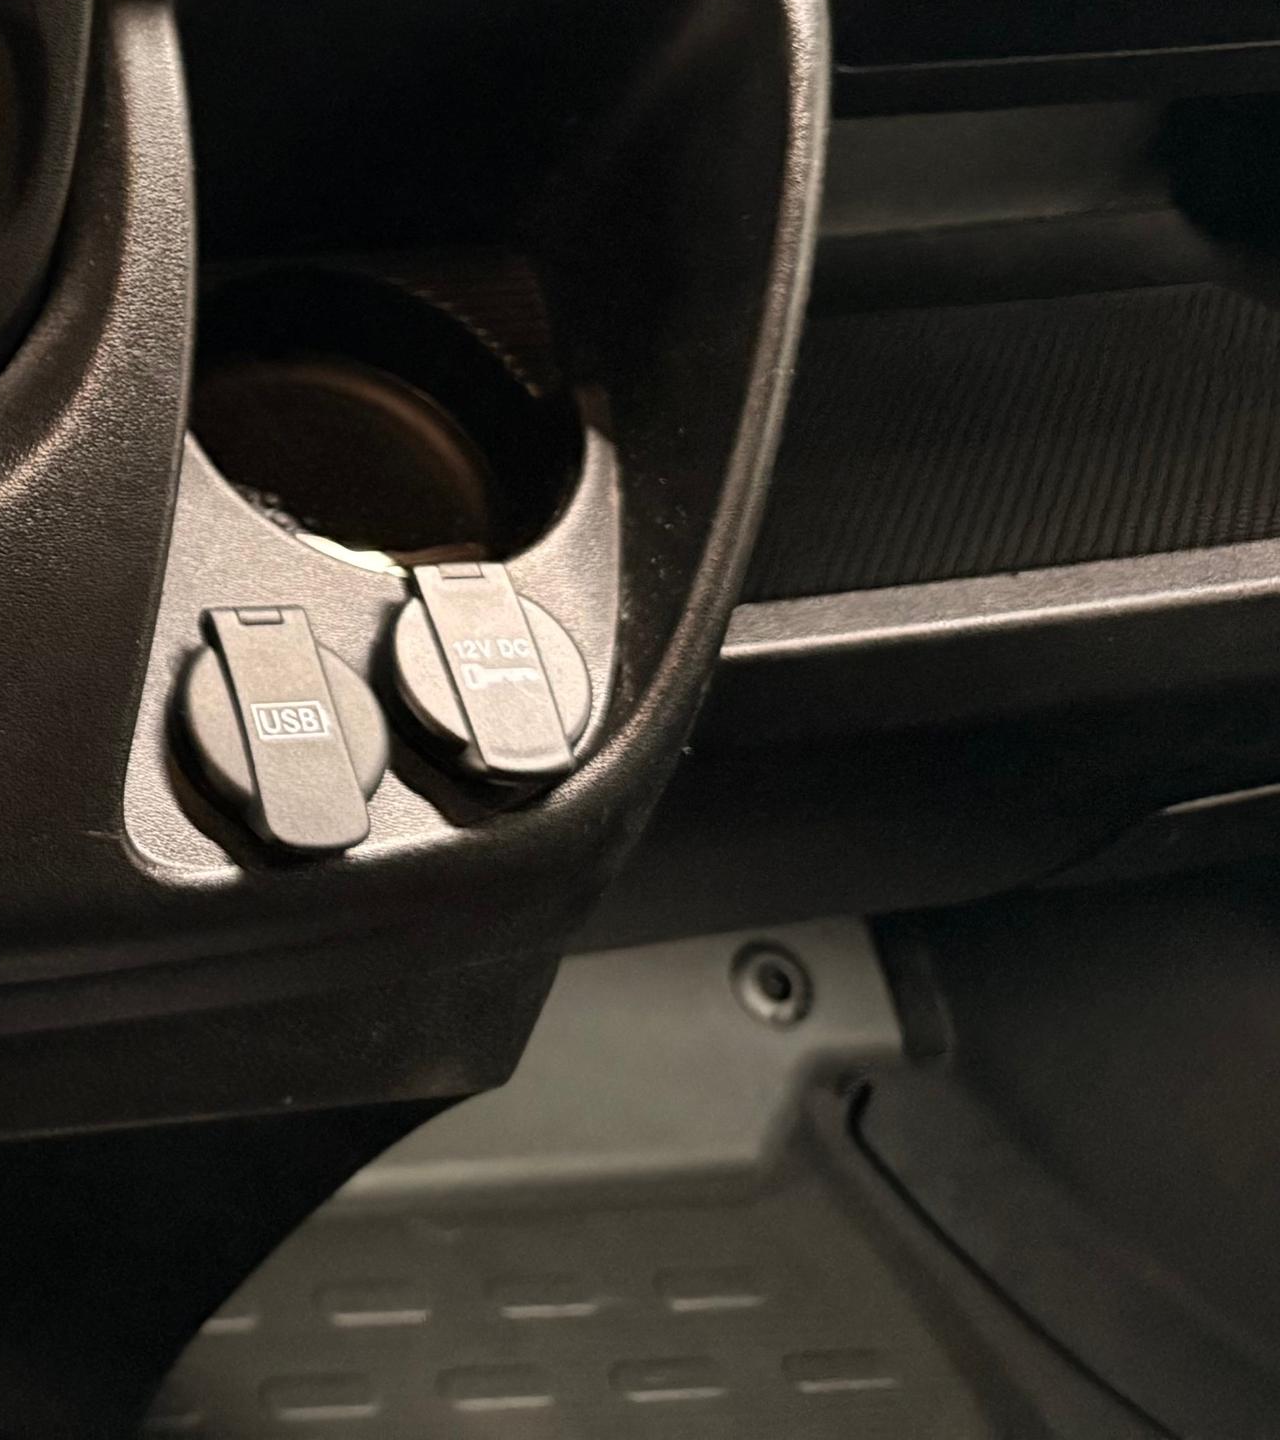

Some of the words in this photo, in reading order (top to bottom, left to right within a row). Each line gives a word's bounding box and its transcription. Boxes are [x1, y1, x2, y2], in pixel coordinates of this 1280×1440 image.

[452, 639, 492, 659] 12V
[496, 637, 531, 659] DC
[259, 706, 322, 736] USB
